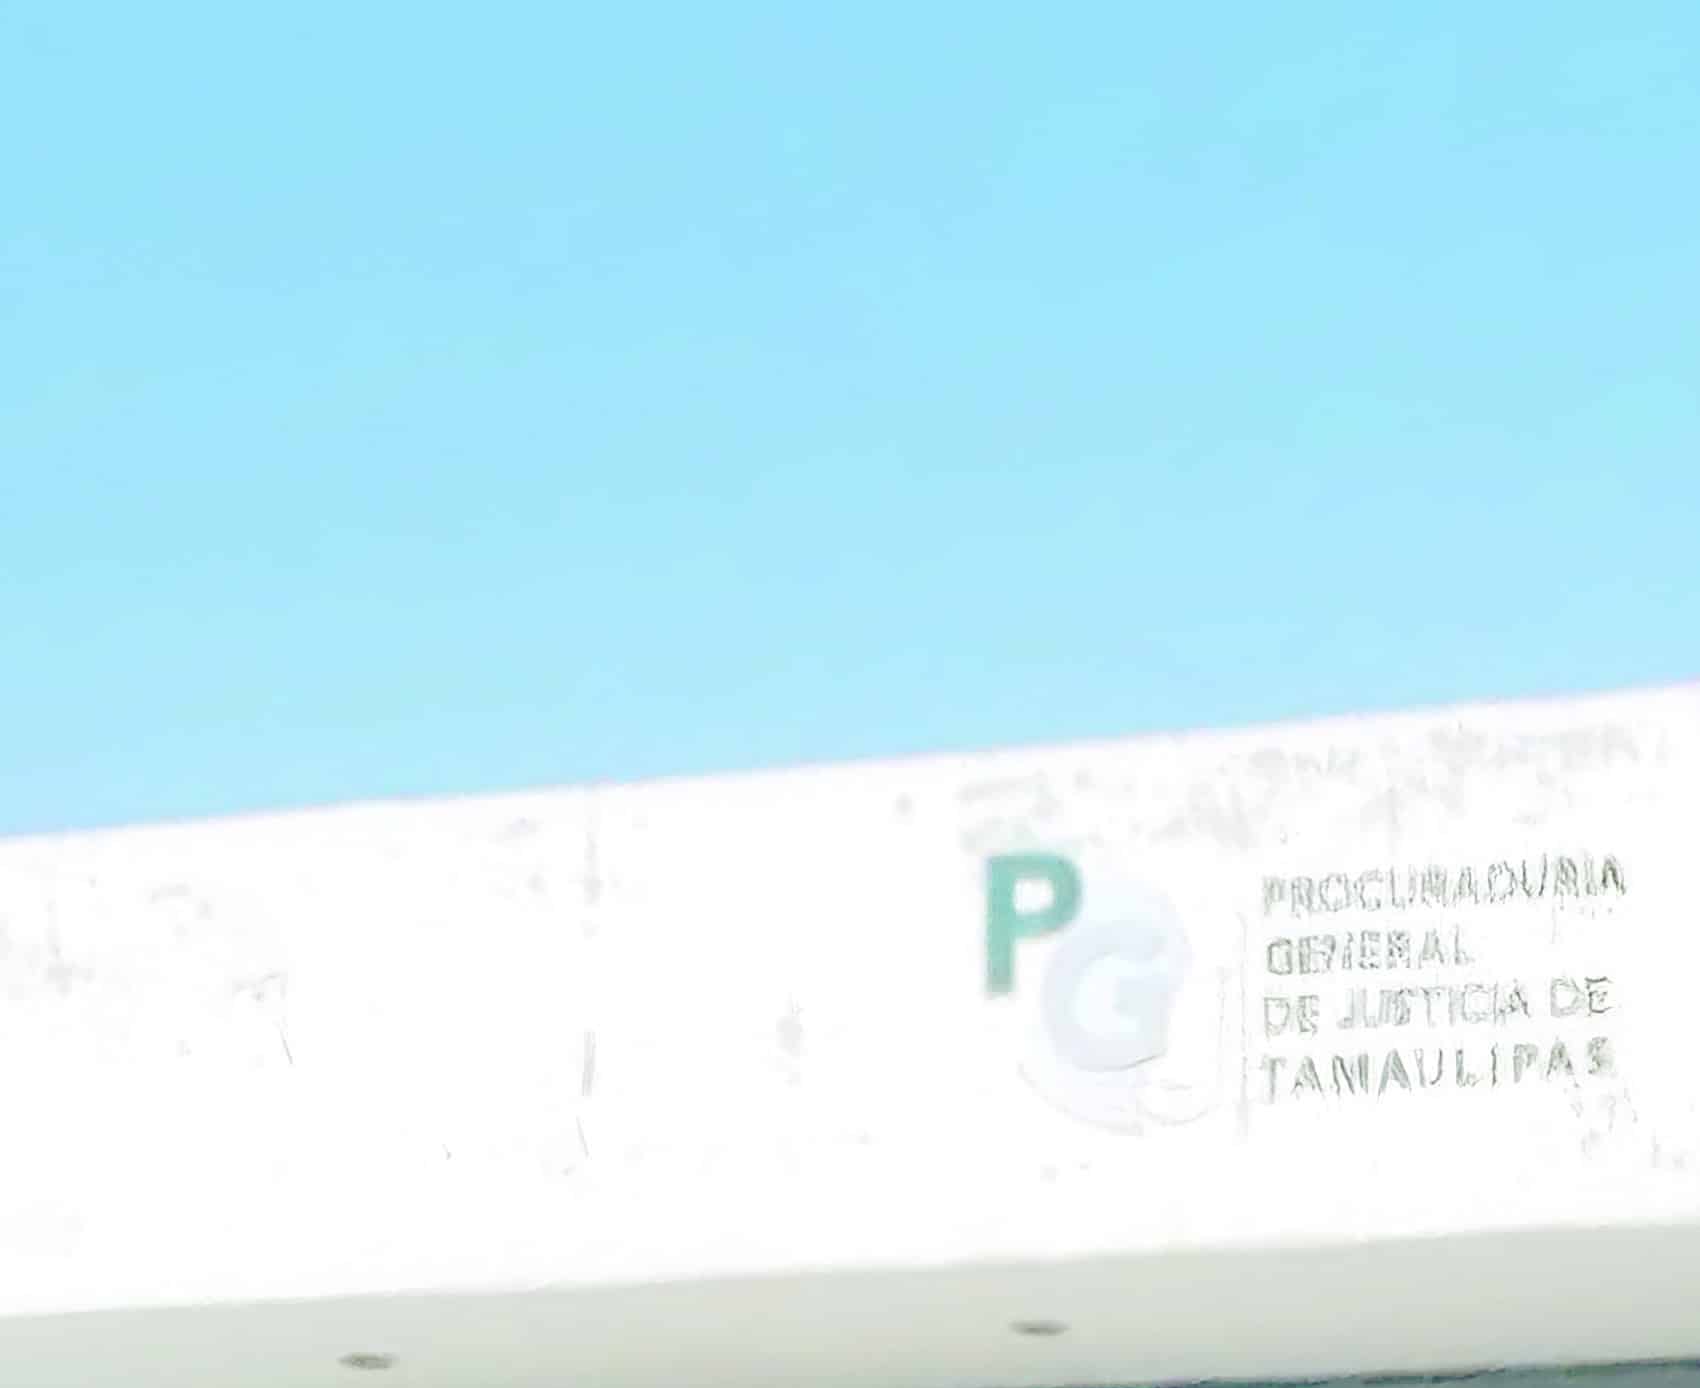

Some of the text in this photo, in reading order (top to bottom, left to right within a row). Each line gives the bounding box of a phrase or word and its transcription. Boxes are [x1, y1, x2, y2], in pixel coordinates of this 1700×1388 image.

[1265, 926, 1473, 976] GENERAL
[1263, 975, 1616, 1037] DE JUSTICIA DE
[1261, 1036, 1617, 1103] TAMAULIPAS
